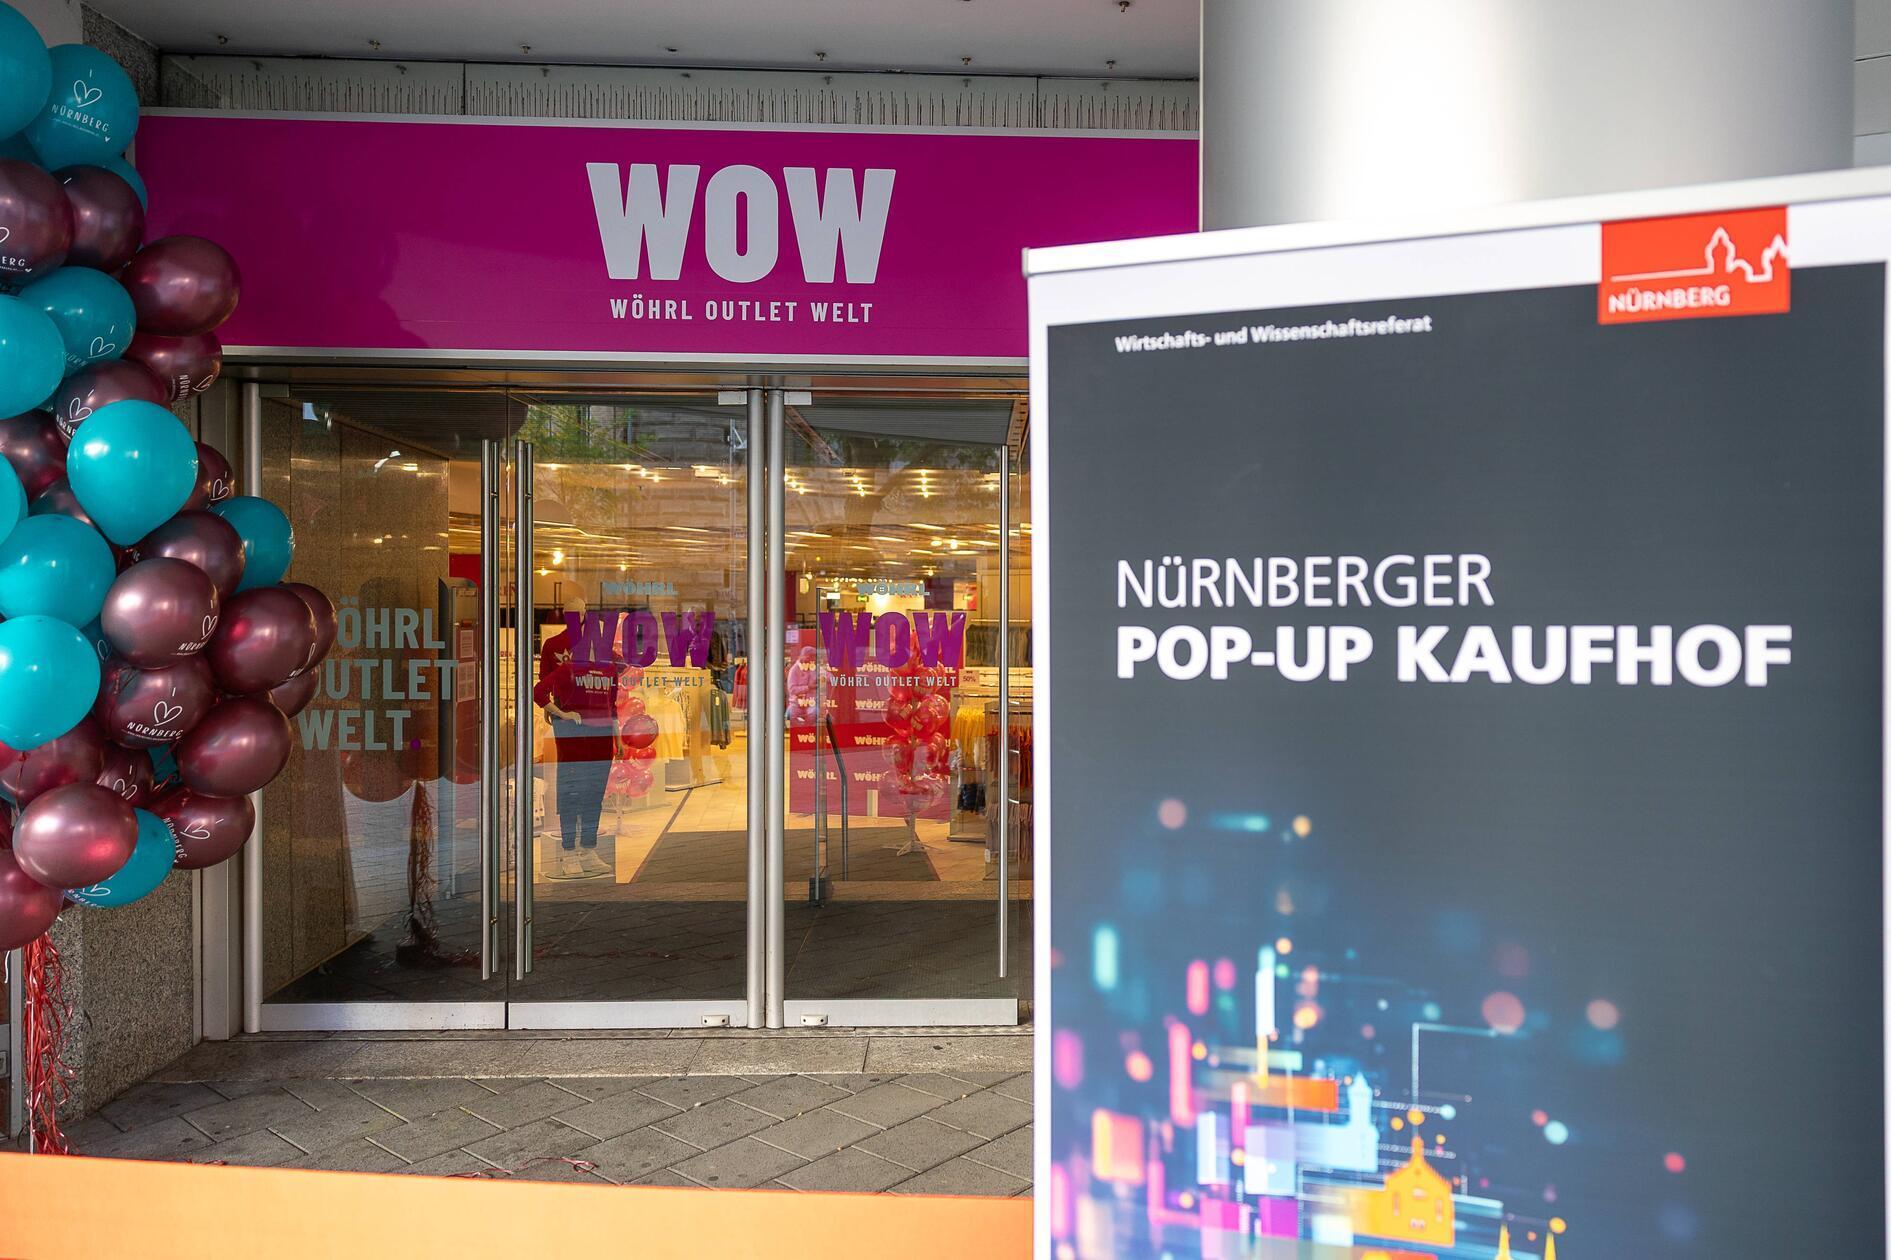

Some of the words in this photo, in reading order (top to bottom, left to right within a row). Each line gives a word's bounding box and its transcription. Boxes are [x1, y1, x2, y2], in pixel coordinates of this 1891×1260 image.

[51, 103, 109, 132] NÜRNBERG
[586, 162, 897, 284] WOW
[2, 256, 26, 267] ERG
[609, 293, 693, 321] WÖHRL
[705, 300, 798, 322] OUTLET
[810, 302, 873, 323] WELT
[1608, 285, 1731, 314] NÜRNBERG
[1114, 330, 1212, 353] Wirtschafts-
[1214, 326, 1248, 346] und
[1250, 314, 1433, 344] Wissenschaftsreferat
[336, 596, 446, 650] ÖHRL
[564, 610, 716, 668] WOW
[818, 611, 967, 668] WOW
[1117, 624, 1375, 682] POP-UP
[1397, 624, 1793, 687] KAUFHOF
[622, 676, 667, 688] OUTLET
[674, 676, 705, 687] WELT
[829, 674, 870, 687] WÖHRL
[875, 676, 920, 687] OUTLET
[926, 676, 957, 687] WELT
[127, 721, 184, 737] NÜRNBERG
